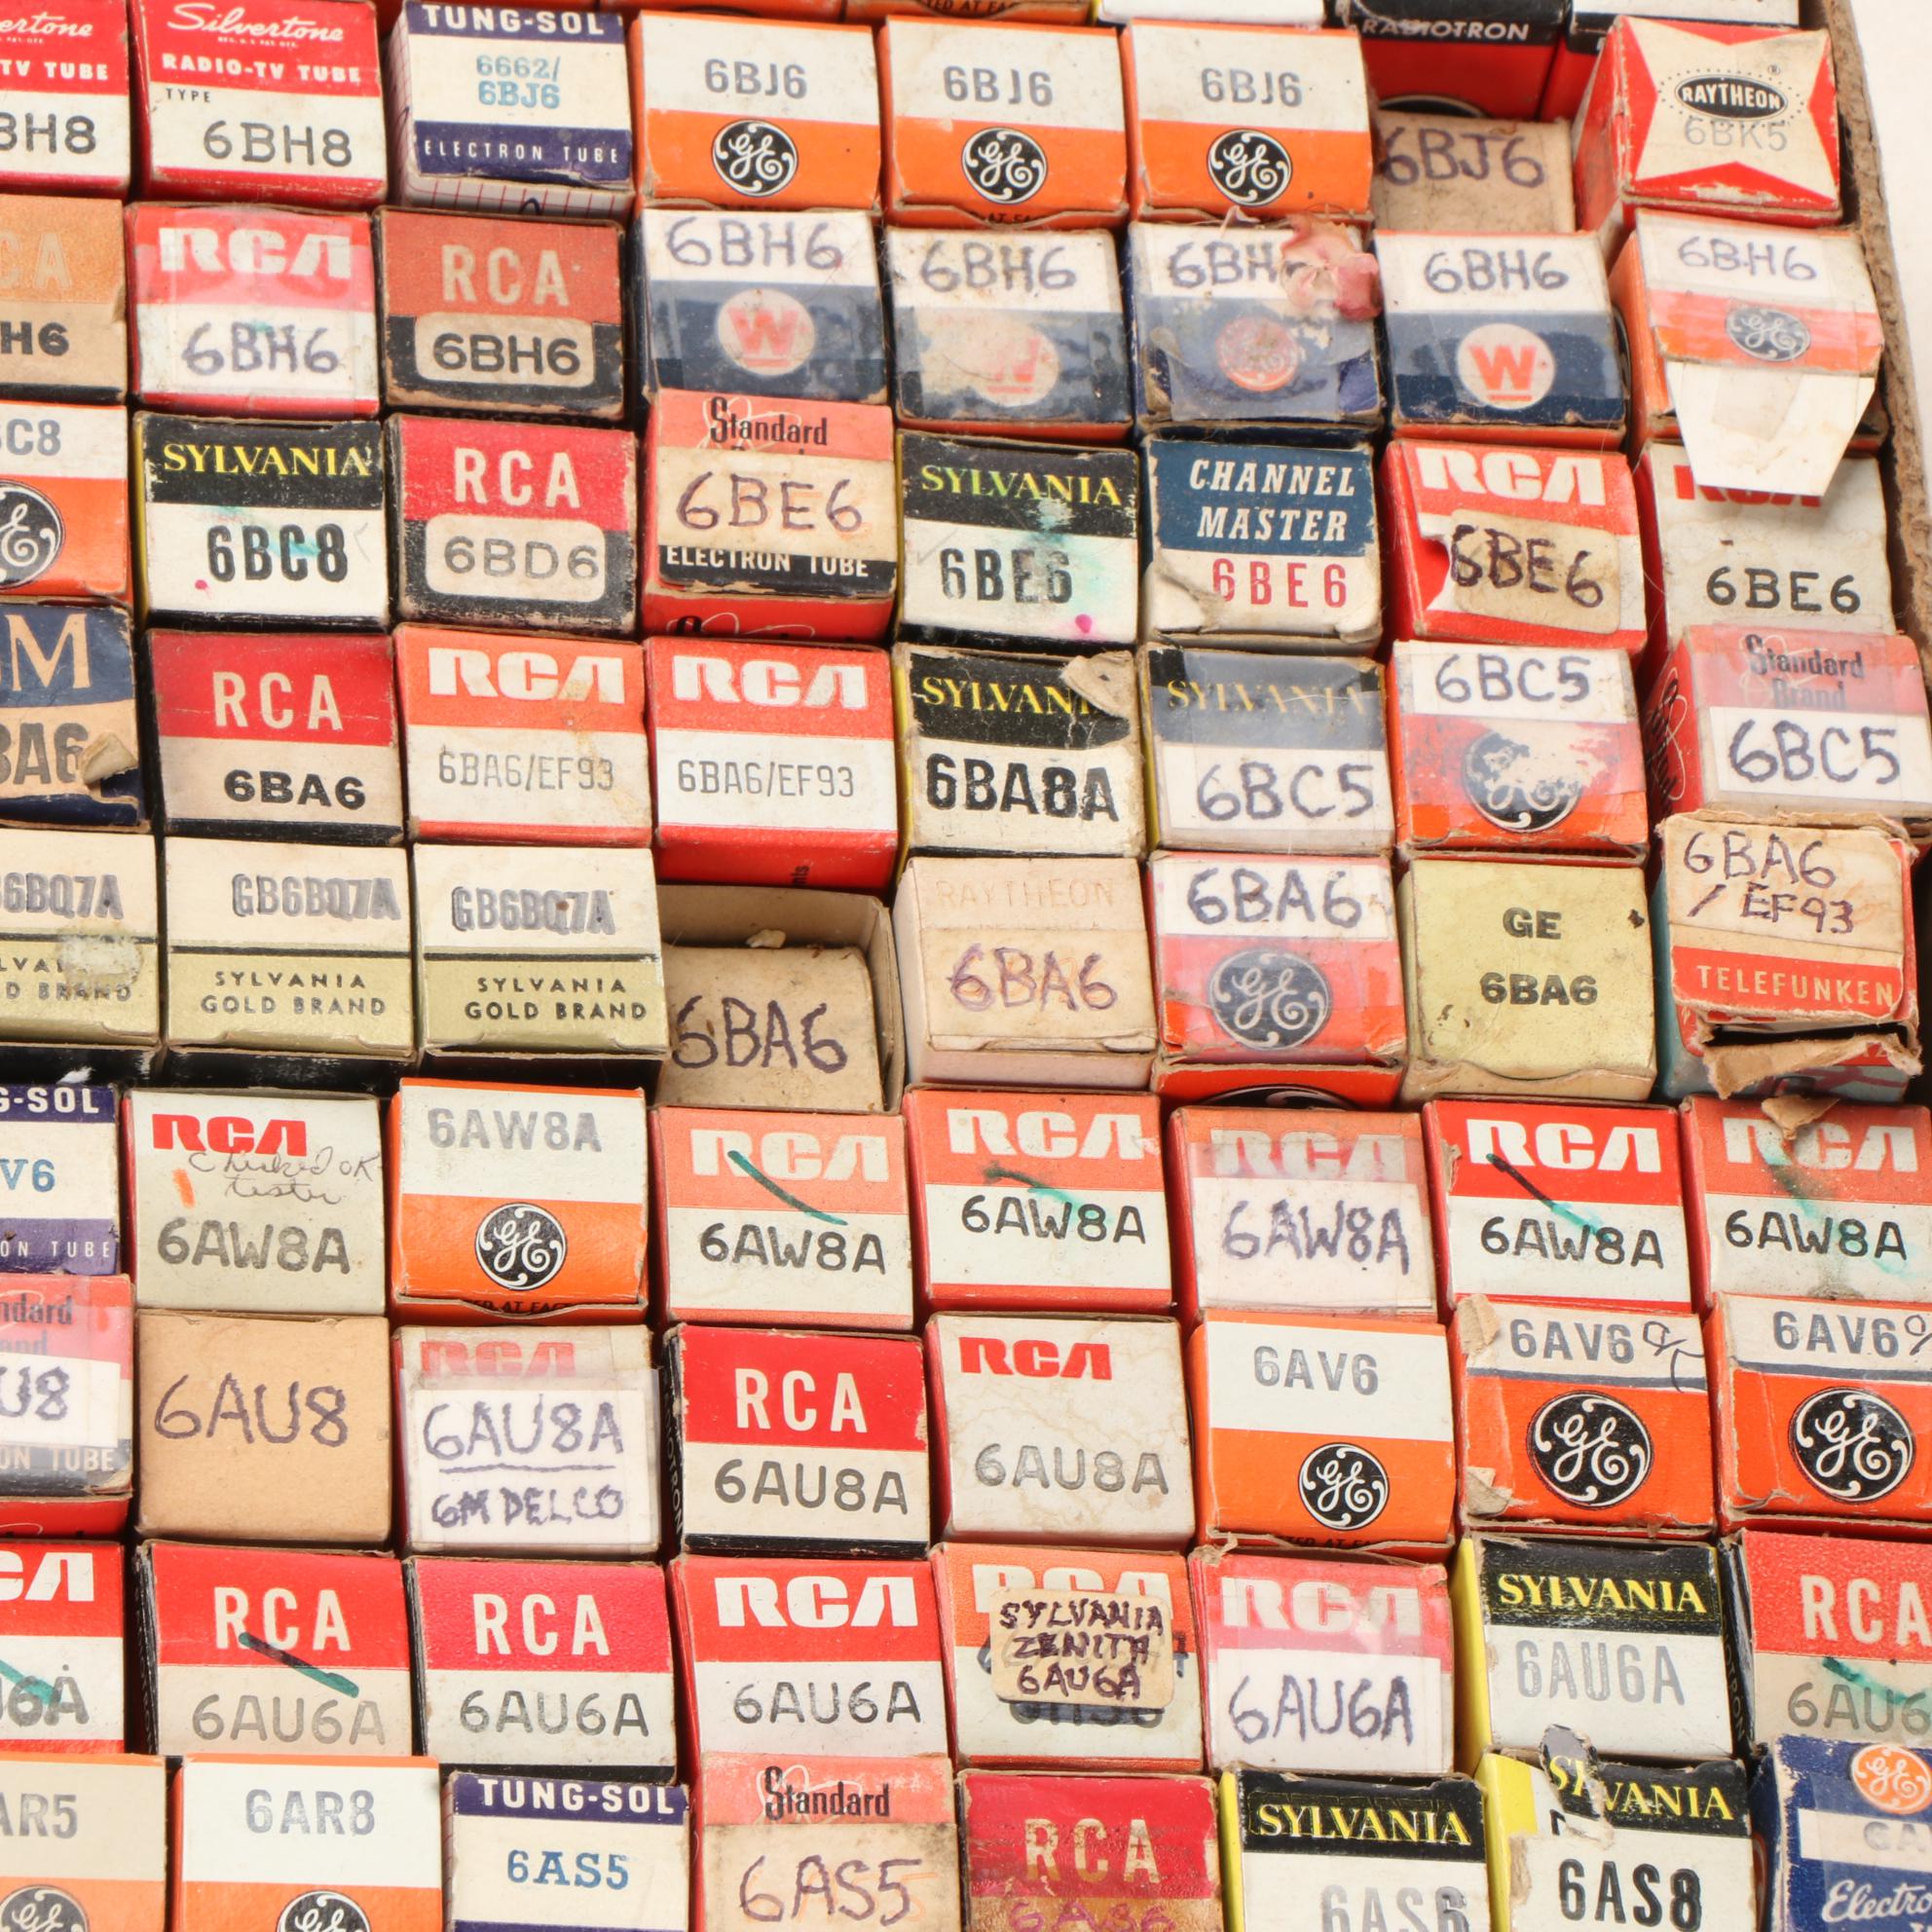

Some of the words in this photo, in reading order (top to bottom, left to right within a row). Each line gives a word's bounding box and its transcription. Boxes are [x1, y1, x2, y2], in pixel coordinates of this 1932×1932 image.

[167, 2, 344, 42] Silvertone
[423, 3, 606, 36] TUNG-SOL
[1362, 19, 1531, 42] RADIOTRON
[44, 62, 109, 81] TUBE
[162, 53, 283, 80] RADIO-TV
[297, 64, 361, 84] TUBE
[475, 55, 561, 82] 6662/
[704, 57, 808, 98] 6BJ6
[943, 65, 1054, 108] 6BJ6
[1201, 67, 1303, 108] 6BJ6
[166, 88, 210, 103] TYPE
[477, 81, 561, 110] 6BJ6
[1680, 83, 1784, 110] RAYTHEON
[204, 120, 353, 167] 6BH8
[424, 138, 542, 162] ELECTRON
[563, 145, 619, 165] TUBE
[1378, 125, 1547, 190] 6BJ6
[1684, 115, 1788, 153] 6BK5
[158, 227, 353, 280] RCA
[665, 214, 843, 270] 6BH6
[919, 240, 1077, 292] 6BH6
[1167, 241, 1307, 288] 6BH
[1677, 234, 1818, 282] 6BH6
[441, 243, 571, 307] RCA
[1424, 247, 1570, 293] 6BH6
[0, 320, 70, 357] H6
[180, 320, 341, 376] 6BH6
[431, 331, 581, 377] 6BH6
[0, 418, 62, 458] C8
[710, 396, 829, 447] Standard
[164, 442, 372, 477] SYLVANIA
[454, 447, 581, 509] RCA
[1189, 458, 1355, 498] CHANNEL
[1414, 447, 1607, 506] RCA
[676, 470, 863, 534] 6BE6
[920, 464, 1124, 507] SYLVANIA
[1196, 505, 1348, 542] MASTER
[206, 523, 349, 584] 6BC8
[443, 535, 601, 582] 6BD6
[666, 544, 792, 573] ELECTRON
[808, 554, 870, 579] TUBE
[939, 547, 1074, 605] 6BE6
[1448, 523, 1605, 610] 6BE6
[1211, 557, 1348, 610] 6BE6
[1705, 565, 1862, 615] 6BE6
[427, 646, 626, 705] RCA
[1434, 651, 1593, 704] 6BC5
[1745, 633, 1866, 680] Standard
[211, 671, 344, 731] RCA
[671, 654, 867, 710] RCA
[1168, 678, 1364, 716] SYLVANIA
[0, 722, 89, 785] A6
[438, 745, 615, 793] 6BA6/EF93
[1728, 718, 1901, 784] 6BC5
[223, 768, 367, 811] 6BA6
[677, 758, 855, 799] 6BA6/EF93
[926, 752, 1121, 823] 6BA8A
[1195, 760, 1375, 820] 6BC5
[231, 873, 401, 922] GB6BQ7A
[450, 885, 617, 936] GB6BQ7A
[935, 875, 1117, 909] RAYTHEON
[1185, 866, 1363, 929] 6BA6
[1502, 906, 1563, 941] GE
[213, 969, 367, 990] SYLVANIA
[476, 976, 627, 995] SYLVANIA
[946, 942, 1118, 1013] 6BA6
[1478, 971, 1600, 1007] 6BA6
[1696, 964, 1894, 1007] TELEFUNKEN
[200, 993, 277, 1017] GOLD
[293, 996, 387, 1018] BRAND
[464, 1000, 540, 1021] GOLD
[554, 1000, 650, 1022] BRAND
[672, 994, 848, 1073] 6BA6
[152, 1112, 308, 1157] RCA
[427, 1107, 603, 1153] 6AW8A
[946, 1108, 1146, 1161] RCA
[1465, 1118, 1662, 1174] RCA
[1722, 1116, 1920, 1173] RCA
[689, 1129, 891, 1183] RCA
[1210, 1129, 1405, 1183] RCA
[961, 1195, 1147, 1245] 6AW8A
[1220, 1197, 1411, 1275] 6AW8A
[1478, 1215, 1665, 1270] 6AW8A
[1725, 1208, 1909, 1262] 6AW8A
[51, 1239, 112, 1259] TUBE
[156, 1217, 352, 1276] 6AW8A
[698, 1222, 886, 1276] 6AW8A
[957, 1336, 1113, 1381] RCA
[1508, 1314, 1635, 1364] 6AV6
[1771, 1310, 1900, 1359] 6AV6
[420, 1340, 577, 1380] RCA
[1252, 1344, 1380, 1396] 6AV6
[153, 1371, 352, 1448] 6AU8
[734, 1367, 869, 1434] RCA
[423, 1393, 625, 1461] 6AU8A
[51, 1448, 115, 1473] TUBE
[974, 1442, 1170, 1496] 6AU8A
[714, 1458, 910, 1515] 6AU8A
[213, 1585, 352, 1651] RCA
[713, 1575, 919, 1628] RCA
[1219, 1576, 1423, 1636] RCA
[1497, 1572, 1705, 1615] SYLVANIA
[1800, 1574, 1932, 1647] RCA
[472, 1592, 611, 1656] RCA
[1016, 1659, 1141, 1702] 6AU6A
[1514, 1637, 1687, 1706] 6AU6A
[192, 1692, 386, 1746] 6AU6A
[459, 1689, 650, 1738] 6AU6A
[732, 1680, 922, 1725] 6AU6A
[1227, 1674, 1415, 1746] 6AU6A
[243, 1787, 377, 1837] 6AR8
[477, 1777, 675, 1815] TUNG-SOL
[764, 1765, 891, 1822] Standard
[1257, 1802, 1472, 1848] SYLVANIA
[505, 1849, 631, 1892] 6AS5
[1023, 1817, 1162, 1885] RCA
[738, 1852, 924, 1928] 6AS5
[1558, 1858, 1702, 1932] 6AS8
